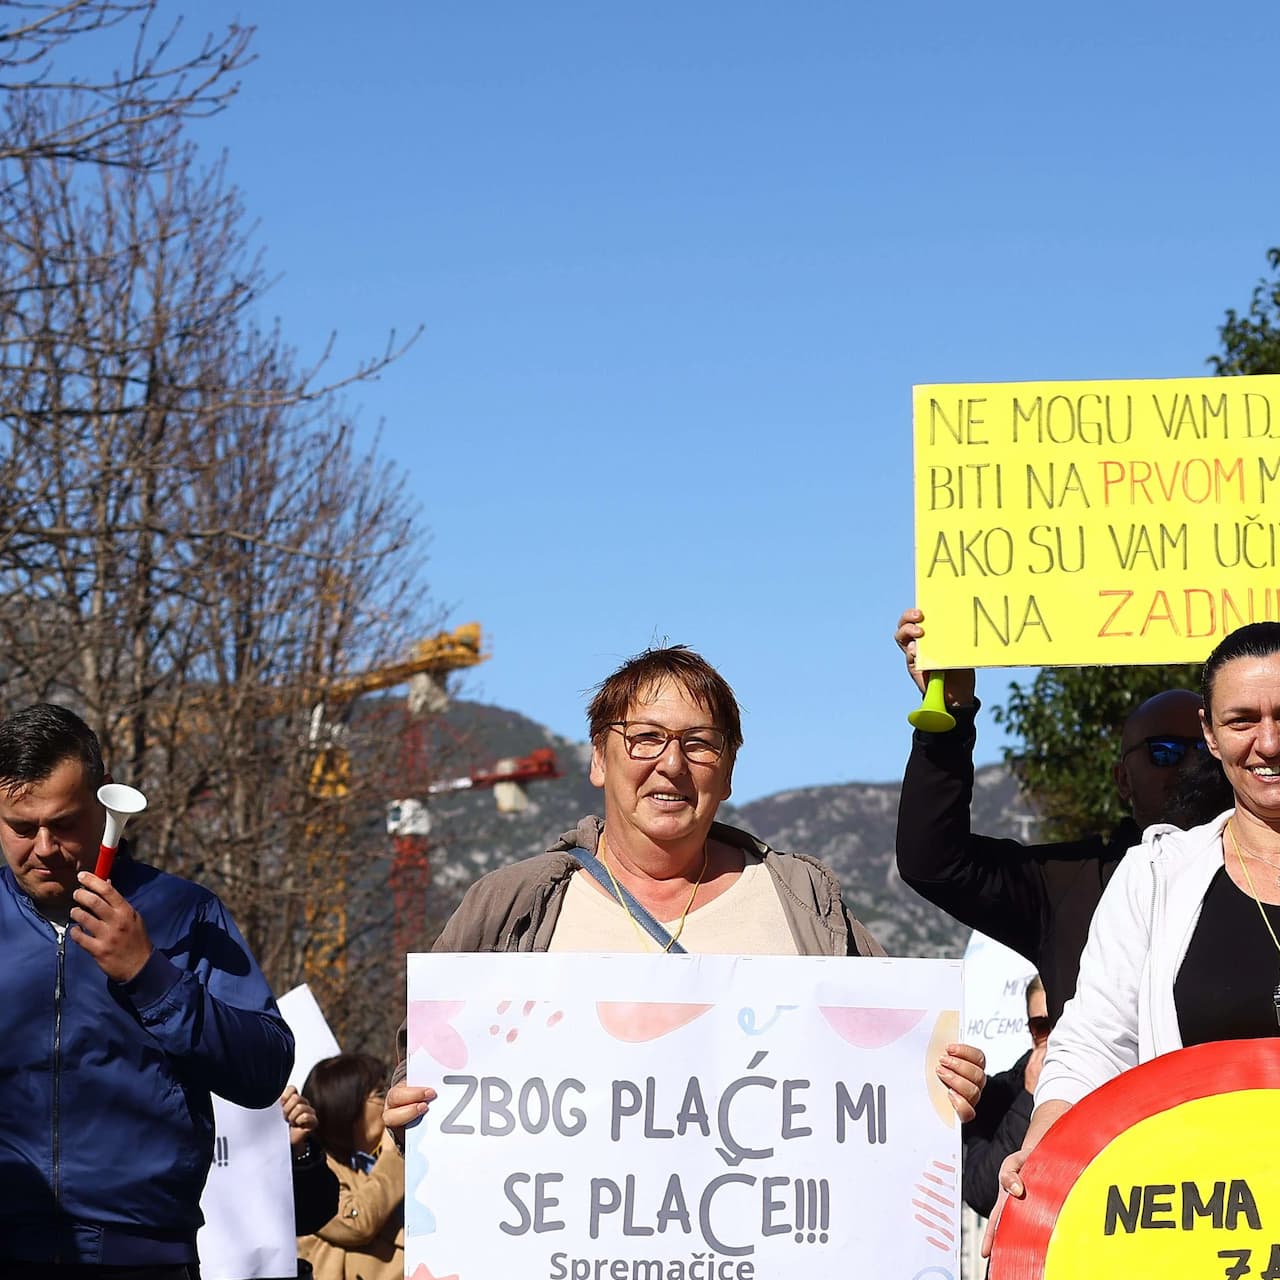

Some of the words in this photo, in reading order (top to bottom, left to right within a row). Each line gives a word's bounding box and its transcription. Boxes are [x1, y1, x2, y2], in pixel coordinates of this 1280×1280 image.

[930, 397, 989, 445] NE
[1013, 395, 1133, 444] MOGU
[1153, 392, 1227, 439] VAM
[928, 464, 1002, 510] BITI
[1027, 462, 1090, 509] NA
[1098, 457, 1245, 505] PRVOM
[927, 527, 1013, 578] AKO
[1028, 525, 1085, 573] SU
[1108, 522, 1187, 571] VAM
[973, 595, 1052, 647] NA
[441, 1076, 586, 1136] ZBOG
[610, 1051, 813, 1160] PLAĆE
[836, 1082, 886, 1144] MI
[500, 1173, 565, 1235] SE
[589, 1146, 830, 1258] PLAČE!!!
[1105, 1180, 1261, 1235] NEMA
